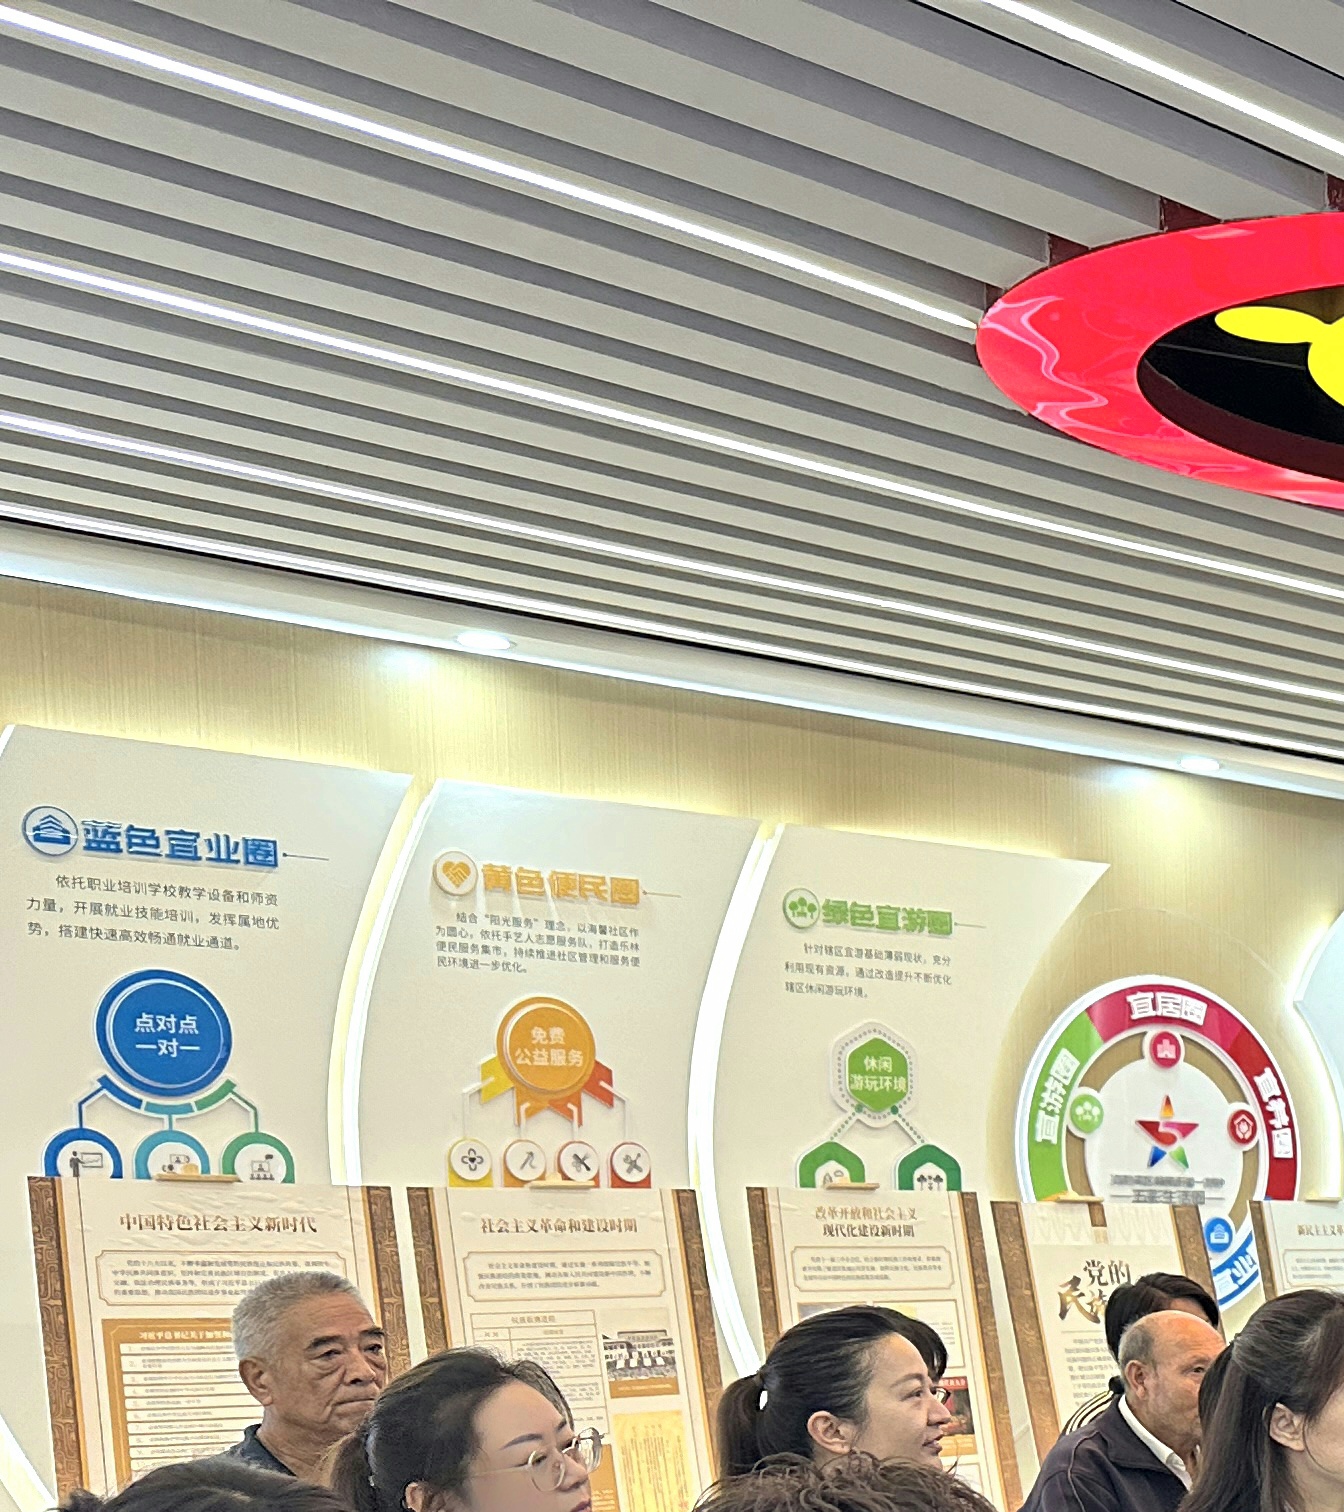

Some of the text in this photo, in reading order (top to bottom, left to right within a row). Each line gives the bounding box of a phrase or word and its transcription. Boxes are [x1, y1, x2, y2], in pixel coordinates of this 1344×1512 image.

[81, 819, 279, 868] 蓝色宜业圈
[55, 874, 278, 907] 依托职业培训学校教学设备和师资
[481, 863, 640, 905] 黄色便民圈
[26, 897, 280, 930] 力量，开展就业技能培训，发挥属地优
[28, 922, 240, 950] 势，搭建快速高效畅通就业通道。
[1126, 991, 1208, 1026] 宜居圈
[134, 1012, 200, 1035] 点对点
[530, 1026, 566, 1045] 免费
[135, 1038, 201, 1059] 一对一
[514, 1048, 584, 1067] 公益服务
[863, 1055, 893, 1073] 休闲
[849, 1073, 907, 1093] 游玩环境
[119, 1212, 318, 1234] 中国特色社会主义新时代
[814, 1206, 918, 1221] 改革开放和社会主义
[480, 1217, 638, 1234] 社会主义革命和建设时期
[822, 1223, 915, 1238] 现代化建设新时期
[1082, 1259, 1132, 1287] 党的
